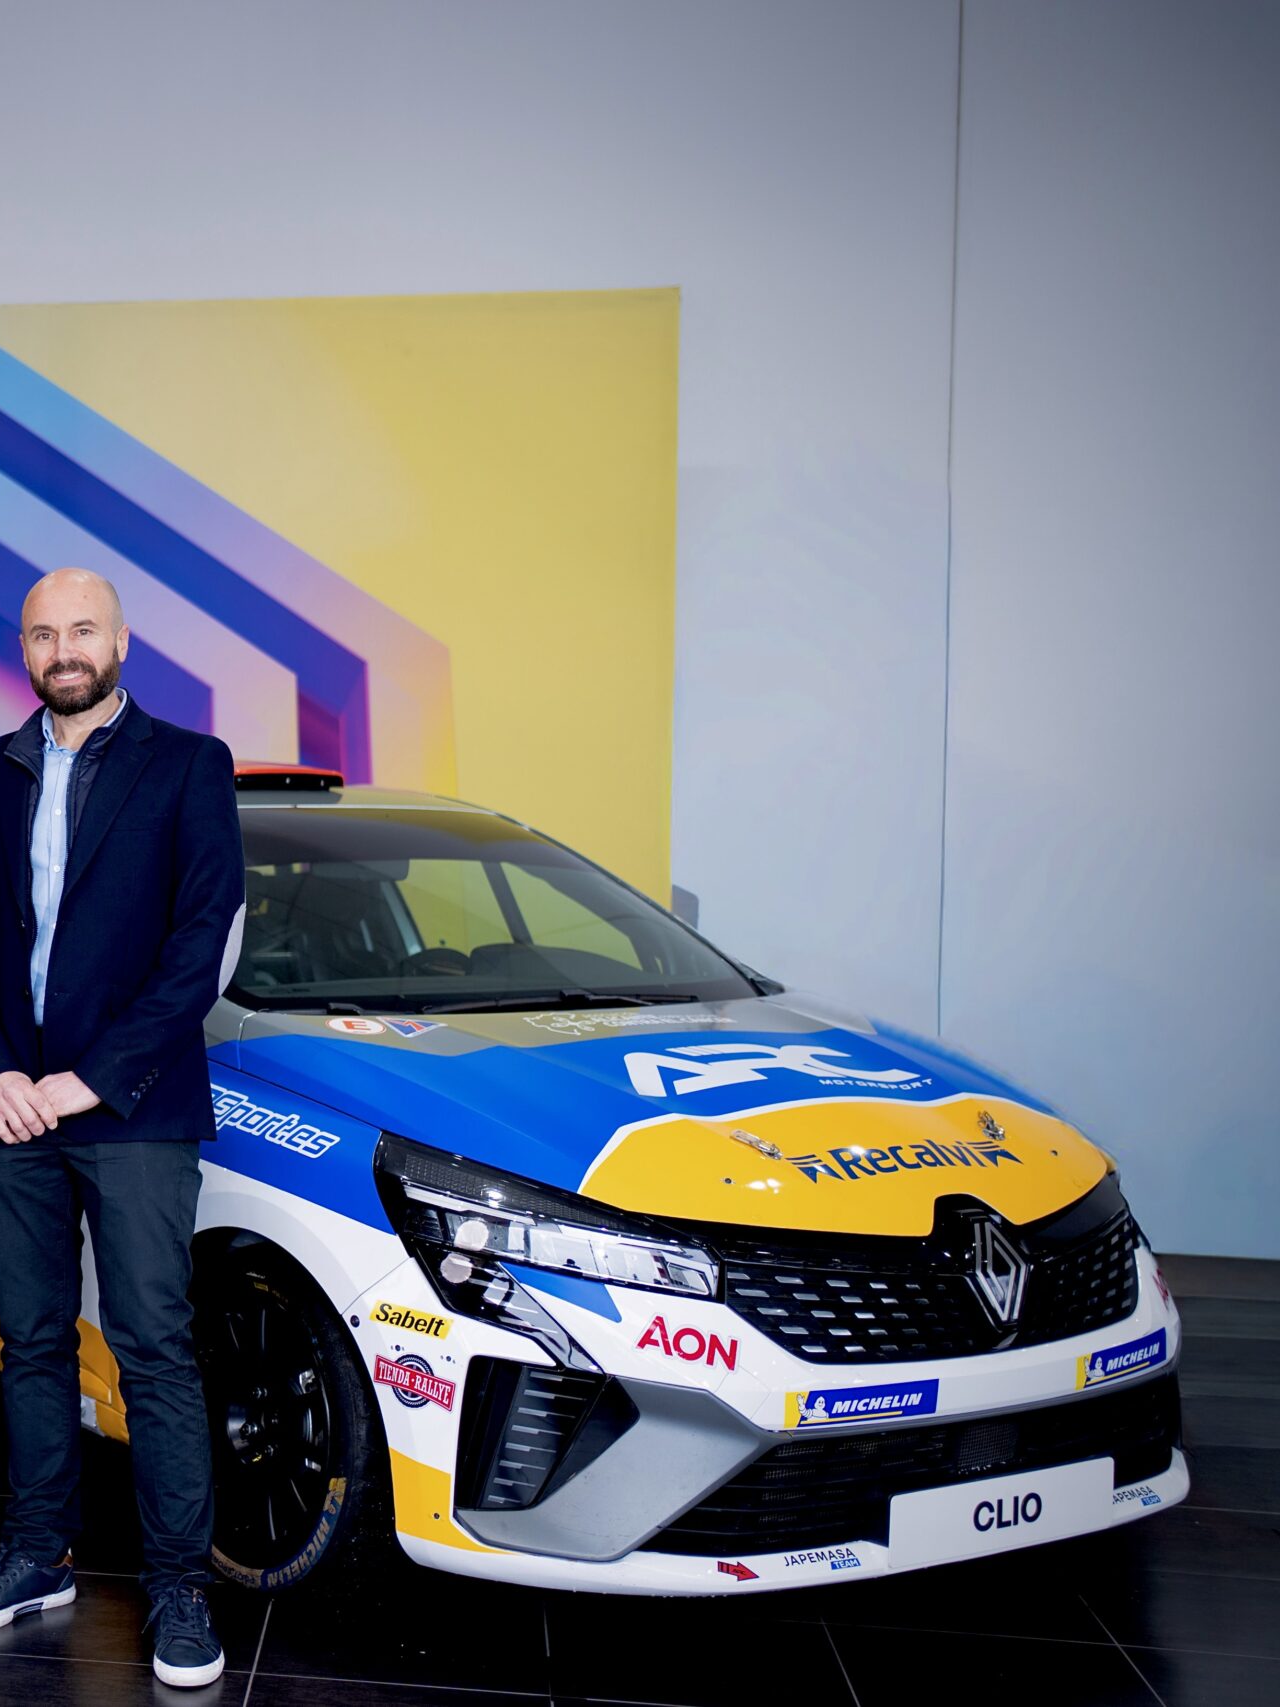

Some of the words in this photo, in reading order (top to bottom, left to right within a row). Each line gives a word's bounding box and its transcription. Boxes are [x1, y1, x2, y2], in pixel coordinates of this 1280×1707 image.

[623, 1043, 921, 1098] ARC
[818, 1078, 933, 1091] MOTORSPORT
[826, 1138, 988, 1180] Recalvi
[375, 1303, 445, 1337] Sabelt
[635, 1315, 738, 1371] AON
[1105, 1341, 1160, 1372] MICHELIN
[379, 1361, 411, 1387] TIENDA
[414, 1375, 451, 1406] RALLYE
[831, 1391, 923, 1415] MICHELIN
[973, 1492, 1043, 1532] CLIO
[1112, 1485, 1156, 1505] APEMASA
[266, 1516, 330, 1588] MICHELIN
[784, 1547, 856, 1567] JAPEMASA
[834, 1558, 859, 1569] TEAM
